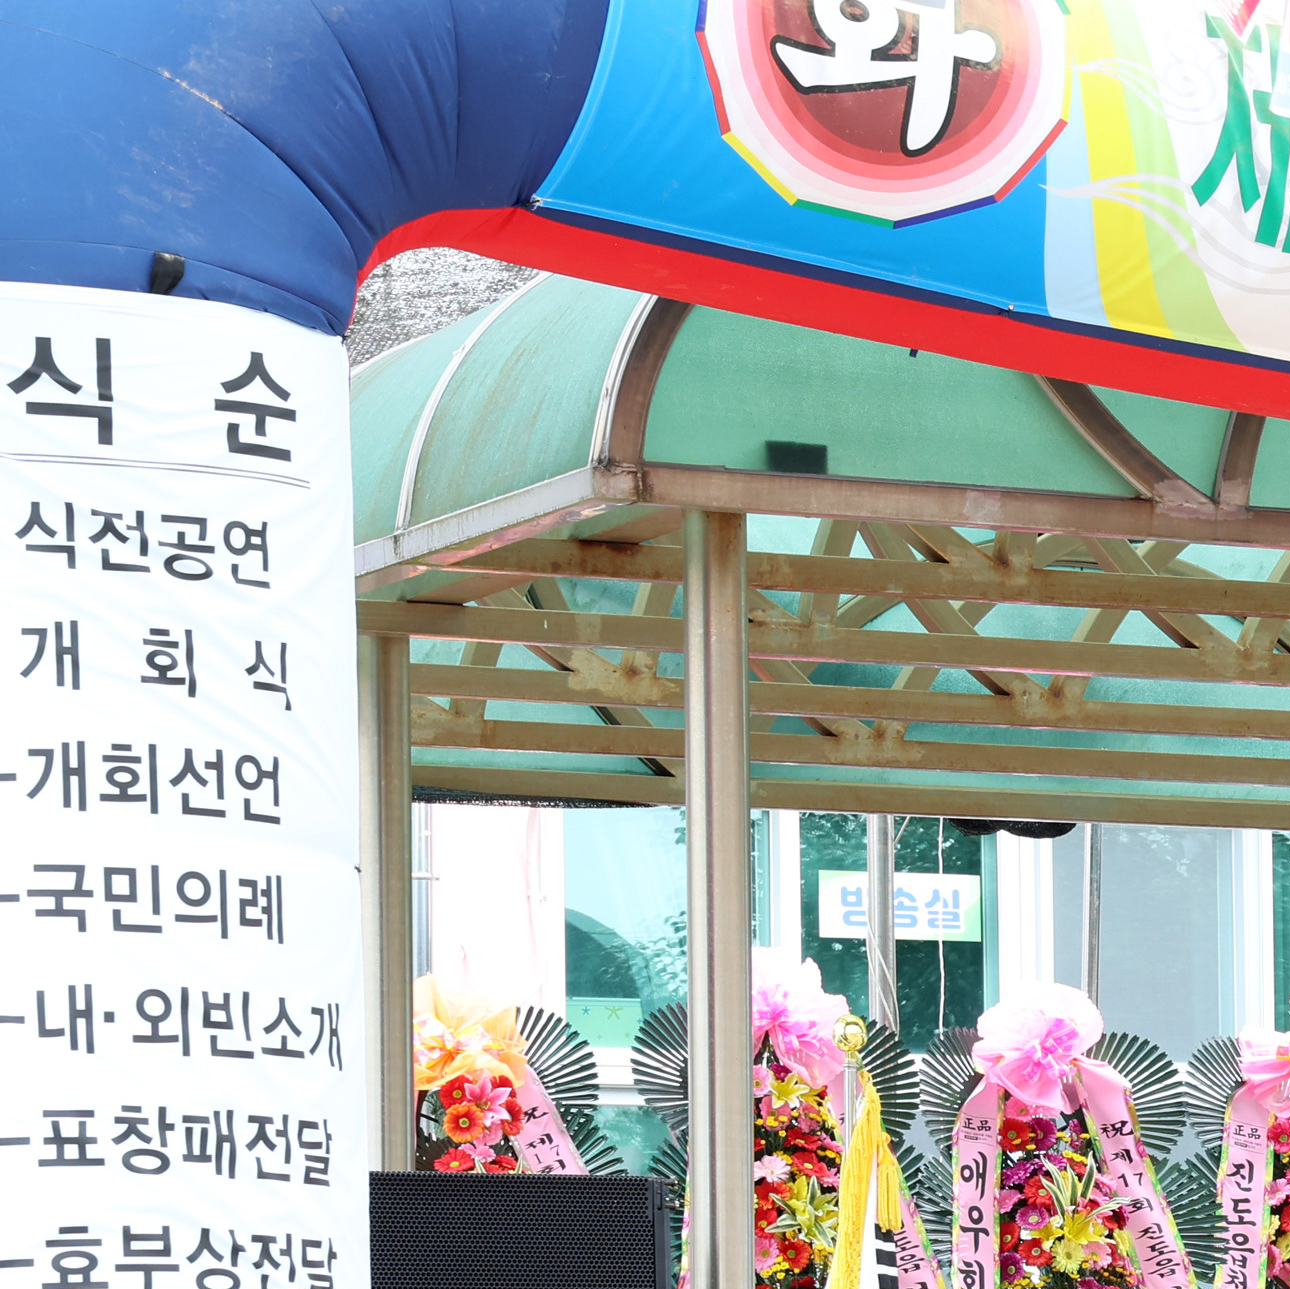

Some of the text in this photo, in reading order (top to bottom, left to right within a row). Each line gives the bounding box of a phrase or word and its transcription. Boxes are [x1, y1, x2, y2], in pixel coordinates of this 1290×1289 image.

[14, 501, 271, 589] 식전공연
[840, 886, 962, 931] 방송실
[1100, 1119, 1134, 1139] 祝
[1135, 1222, 1182, 1281] 진도읍
